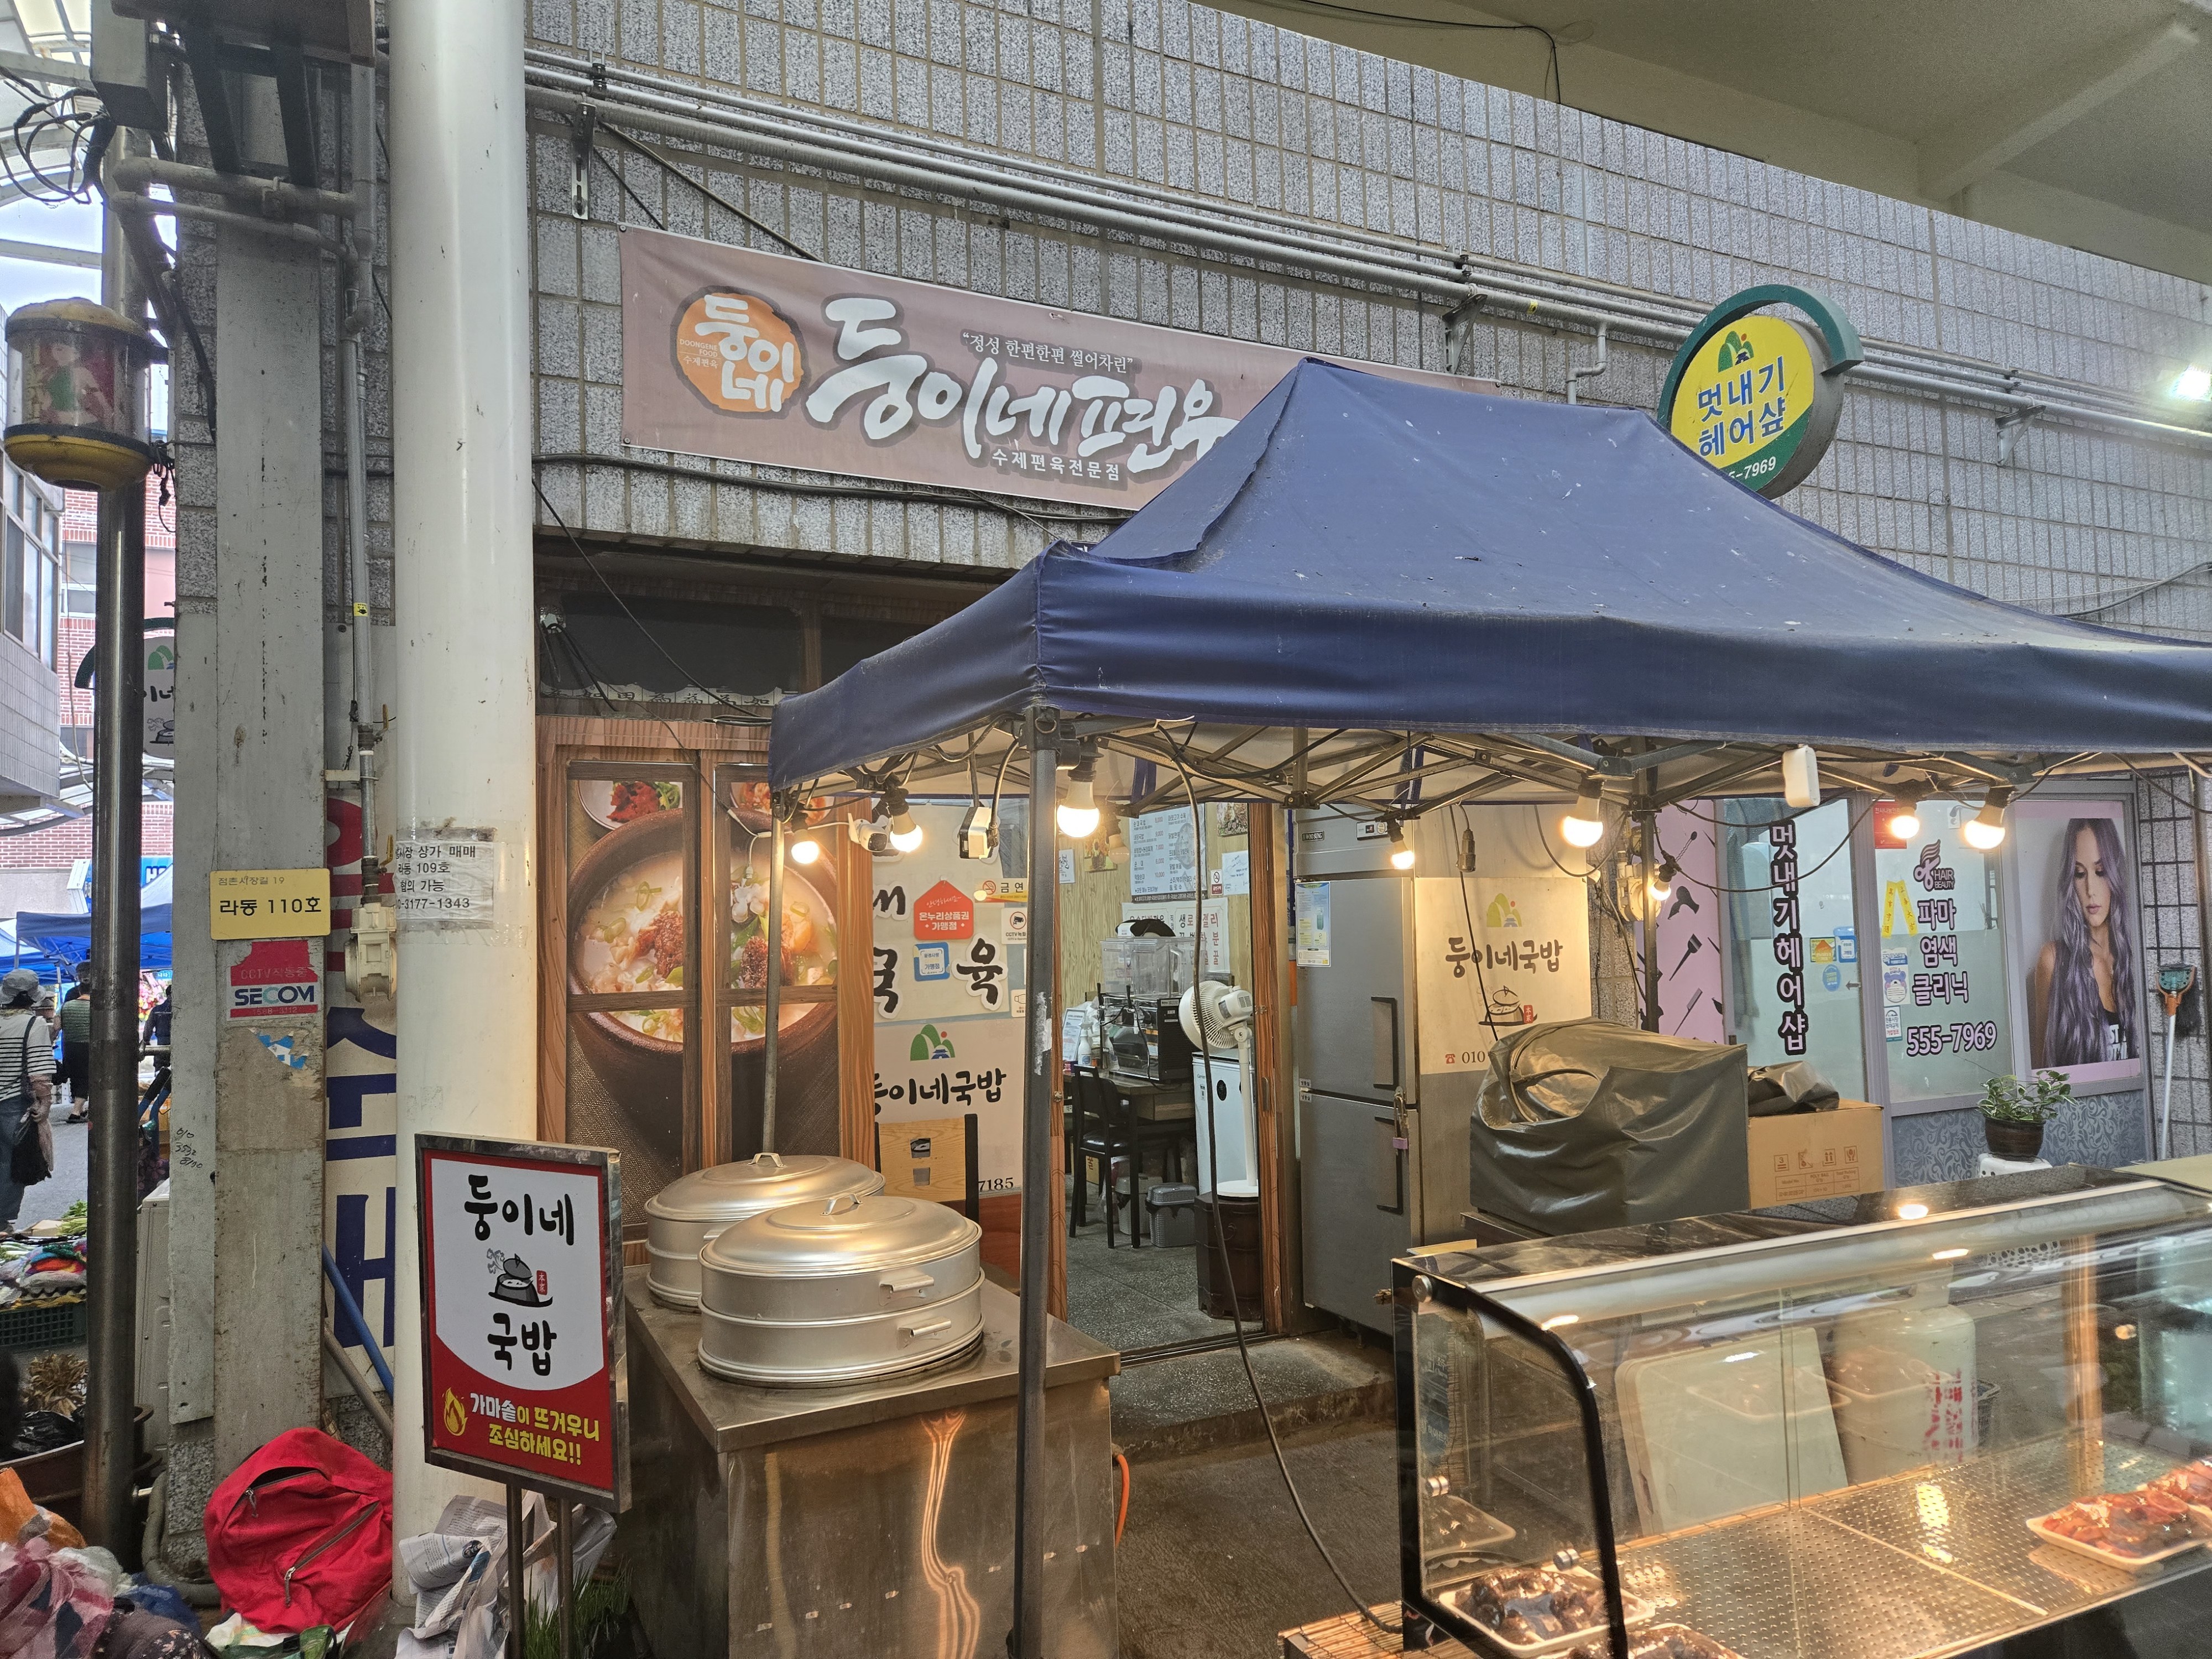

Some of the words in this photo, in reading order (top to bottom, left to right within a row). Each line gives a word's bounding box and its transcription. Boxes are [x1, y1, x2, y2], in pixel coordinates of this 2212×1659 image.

[680, 338, 718, 352] DOONGENE
[695, 294, 795, 413] 둥이네
[699, 348, 718, 358] FOOD
[1005, 340, 1065, 364] 한편한편
[683, 356, 718, 369] 수제편육
[1698, 356, 1785, 422] 멋내기
[992, 448, 1119, 481] 수제편육전문점
[418, 846, 441, 858] 상가
[449, 846, 476, 858] 매매
[417, 862, 450, 873] 109호
[1934, 871, 1954, 880] HAIR
[218, 876, 268, 885] 점촌시장길
[400, 880, 415, 892] 협의
[421, 879, 445, 892] 가능
[220, 900, 258, 916] 라동
[268, 896, 322, 914] 110호
[919, 911, 969, 921] 온누리상품권
[1918, 899, 1956, 930] 파마
[932, 922, 957, 931] 가맹점
[1179, 912, 1218, 927] 생로젤리
[1446, 937, 1563, 978] 둥이네국밥
[1921, 936, 1957, 966] 염색
[234, 985, 315, 1006] SECOM
[1913, 973, 1969, 1005] 클리닉
[1907, 1021, 1997, 1056] 555-7969
[1462, 1051, 1486, 1064] 010
[177, 1128, 195, 1138] 010
[978, 1177, 1014, 1192] 7185
[464, 1173, 574, 1246] 둥이네
[487, 1312, 557, 1376] 국밥
[471, 1391, 530, 1425] 가마솥이
[534, 1406, 600, 1442] 뜨거우니
[489, 1423, 582, 1465] 조심하세요!!
